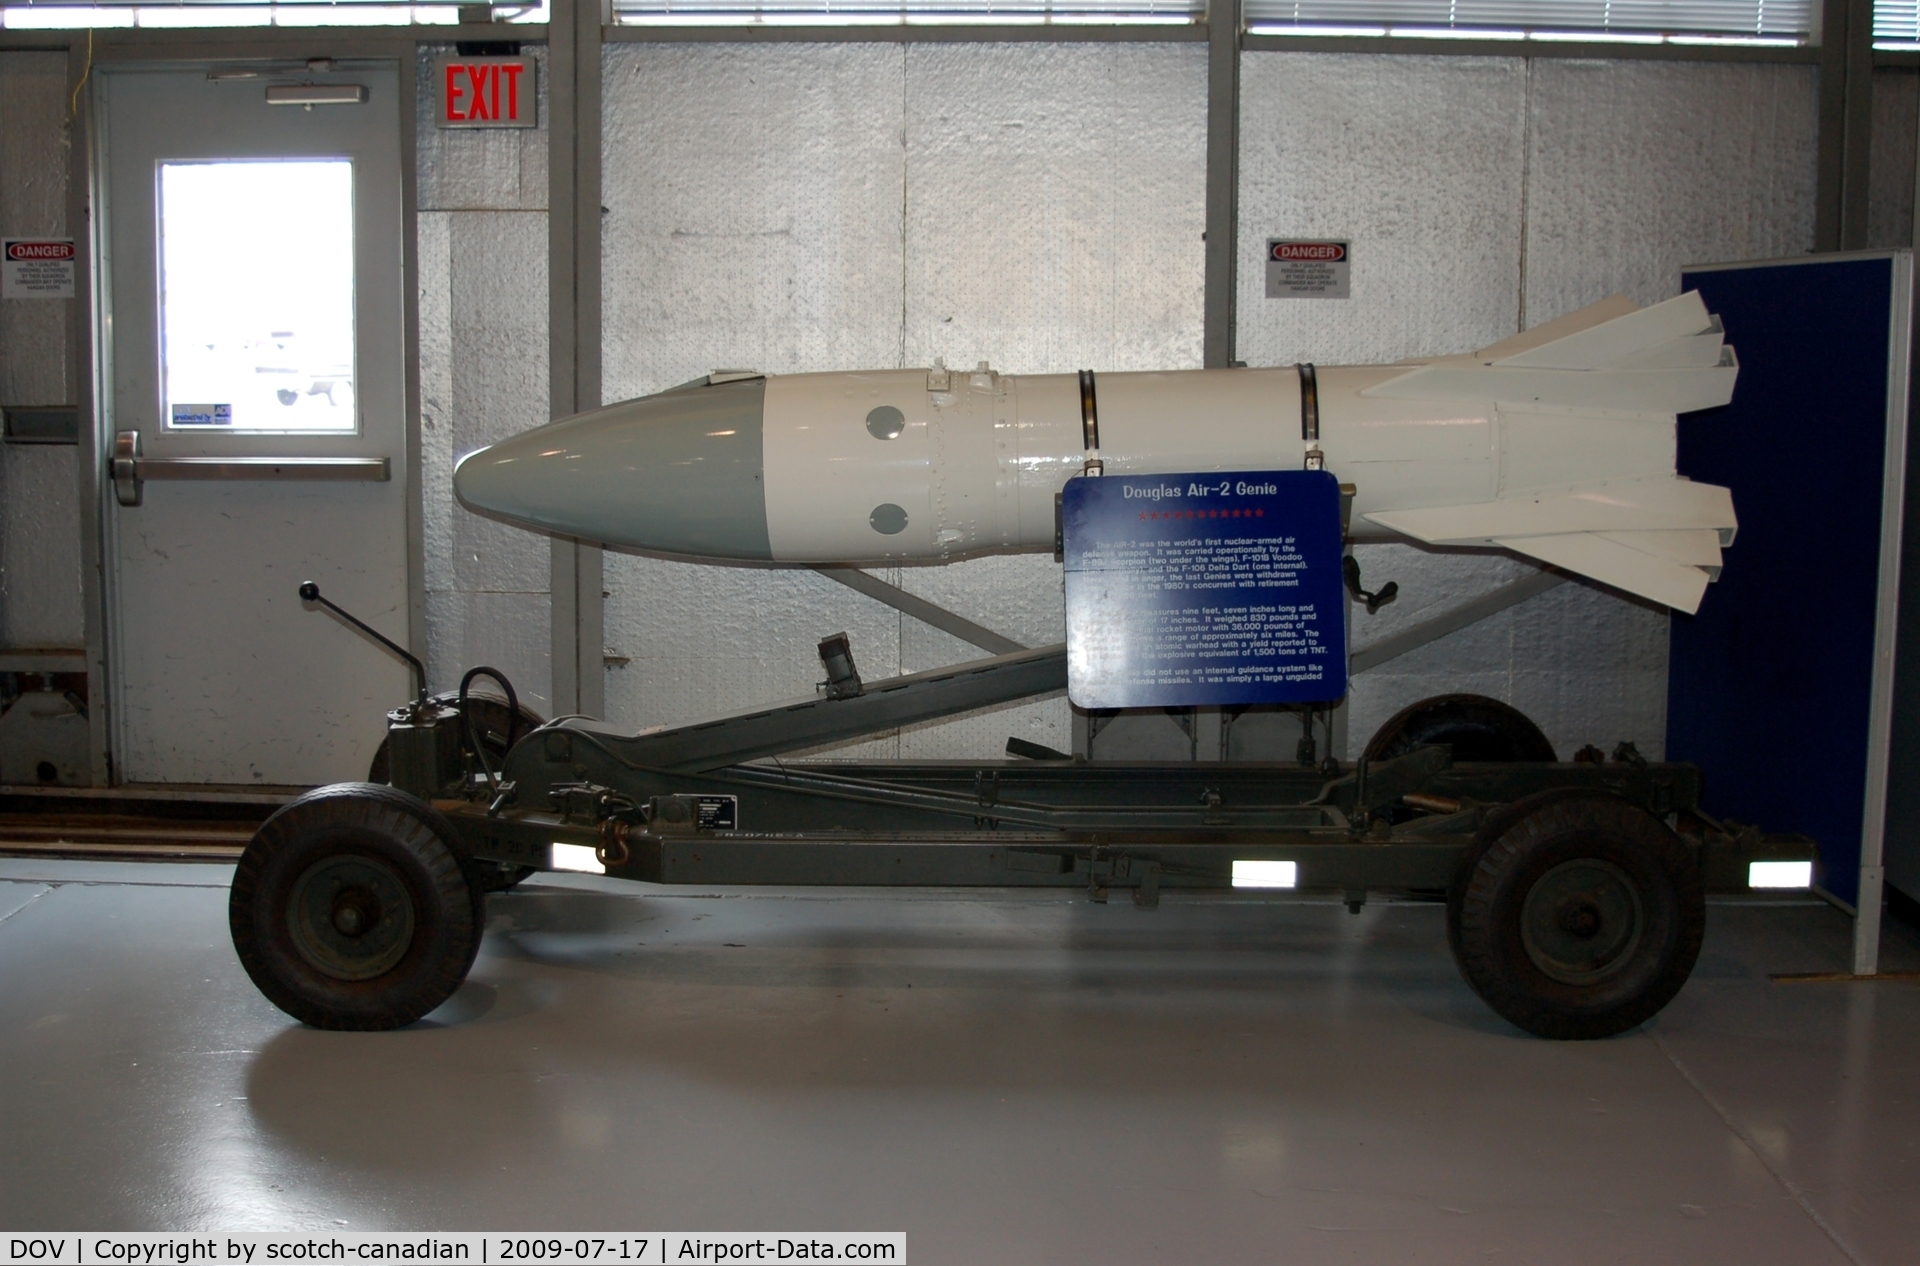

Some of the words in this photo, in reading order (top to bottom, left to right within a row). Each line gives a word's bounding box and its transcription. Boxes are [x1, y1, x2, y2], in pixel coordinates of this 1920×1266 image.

[446, 64, 524, 121] EXIT
[16, 245, 69, 257] DANGER
[1281, 246, 1336, 258] DANGER
[1122, 483, 1182, 501] Douglas
[1187, 482, 1230, 497] Air-2
[1236, 481, 1278, 496] Genie
[1096, 541, 1111, 549] The
[1113, 540, 1136, 549] AIR-2
[1173, 538, 1202, 547] world's
[1205, 538, 1222, 546] first
[1224, 536, 1283, 546] nuclear-armed
[1284, 536, 1296, 544] air
[1117, 550, 1151, 559] weapon.
[1157, 548, 1163, 556] It
[1184, 546, 1213, 555] carried
[1215, 545, 1267, 555] operationally
[1269, 545, 1280, 554] by
[1282, 544, 1296, 552] the
[1148, 556, 1167, 565] (two
[1169, 556, 1192, 564] under
[1195, 555, 1209, 563] the
[1211, 554, 1240, 564] wings),
[1242, 554, 1270, 562] F-101B
[1272, 552, 1303, 561] Voodoo
[1148, 565, 1163, 573] and
[1166, 564, 1180, 573] the
[1181, 563, 1206, 572] F-106
[1208, 562, 1230, 571] Delta
[1232, 562, 1250, 571] Dart
[1252, 562, 1271, 571] (one
[1273, 560, 1308, 570] internal).
[1131, 573, 1139, 581] in
[1141, 574, 1167, 583] anger,
[1169, 572, 1183, 581] the
[1185, 571, 1201, 580] last
[1203, 571, 1232, 580] Genies
[1256, 569, 1297, 578] withdrawn
[1137, 582, 1145, 590] in
[1147, 582, 1161, 590] the
[1163, 581, 1190, 590] 1980's
[1192, 580, 1236, 589] concurrent
[1239, 580, 1256, 588] with
[1258, 578, 1299, 587] retirement
[1141, 608, 1180, 616] measures
[1182, 607, 1199, 615] nine
[1202, 606, 1221, 615] feet,
[1223, 606, 1247, 614] seven
[1249, 605, 1276, 613] inches
[1278, 604, 1296, 614] long
[1298, 603, 1314, 612] and
[1160, 616, 1168, 624] 17
[1170, 616, 1200, 624] inches.
[1205, 615, 1211, 623] It
[1214, 614, 1248, 623] weighed
[1250, 613, 1267, 622] 830
[1269, 613, 1299, 622] pounds
[1301, 612, 1317, 620] and
[1156, 625, 1182, 633] rocket
[1185, 624, 1209, 632] motor
[1212, 623, 1229, 631] with
[1231, 622, 1261, 631] 36,000
[1263, 621, 1293, 631] pounds
[1295, 621, 1305, 629] of
[1164, 634, 1187, 643] range
[1190, 632, 1199, 641] of
[1202, 631, 1258, 641] approximately
[1260, 630, 1273, 639] six
[1275, 630, 1298, 638] miles.
[1304, 629, 1320, 637] The
[1155, 642, 1182, 650] atomic
[1185, 641, 1219, 649] warhead
[1221, 640, 1239, 648] with
[1249, 639, 1269, 649] yield
[1271, 638, 1306, 648] reported
[1308, 638, 1317, 646] to
[1157, 650, 1196, 660] explosive
[1198, 649, 1240, 659] equivalent
[1241, 648, 1251, 656] of
[1253, 647, 1276, 657] 1,500
[1278, 647, 1296, 655] tons
[1309, 645, 1328, 654] TNT.
[1143, 668, 1156, 676] did
[1158, 668, 1172, 676] not
[1205, 666, 1235, 674] internal
[1237, 665, 1274, 675] guidance
[1276, 665, 1306, 673] system
[1308, 663, 1323, 671] like
[1157, 676, 1193, 684] missiles.
[1226, 674, 1252, 684] simply
[1262, 674, 1283, 683] large
[1285, 672, 1323, 682] unguided
